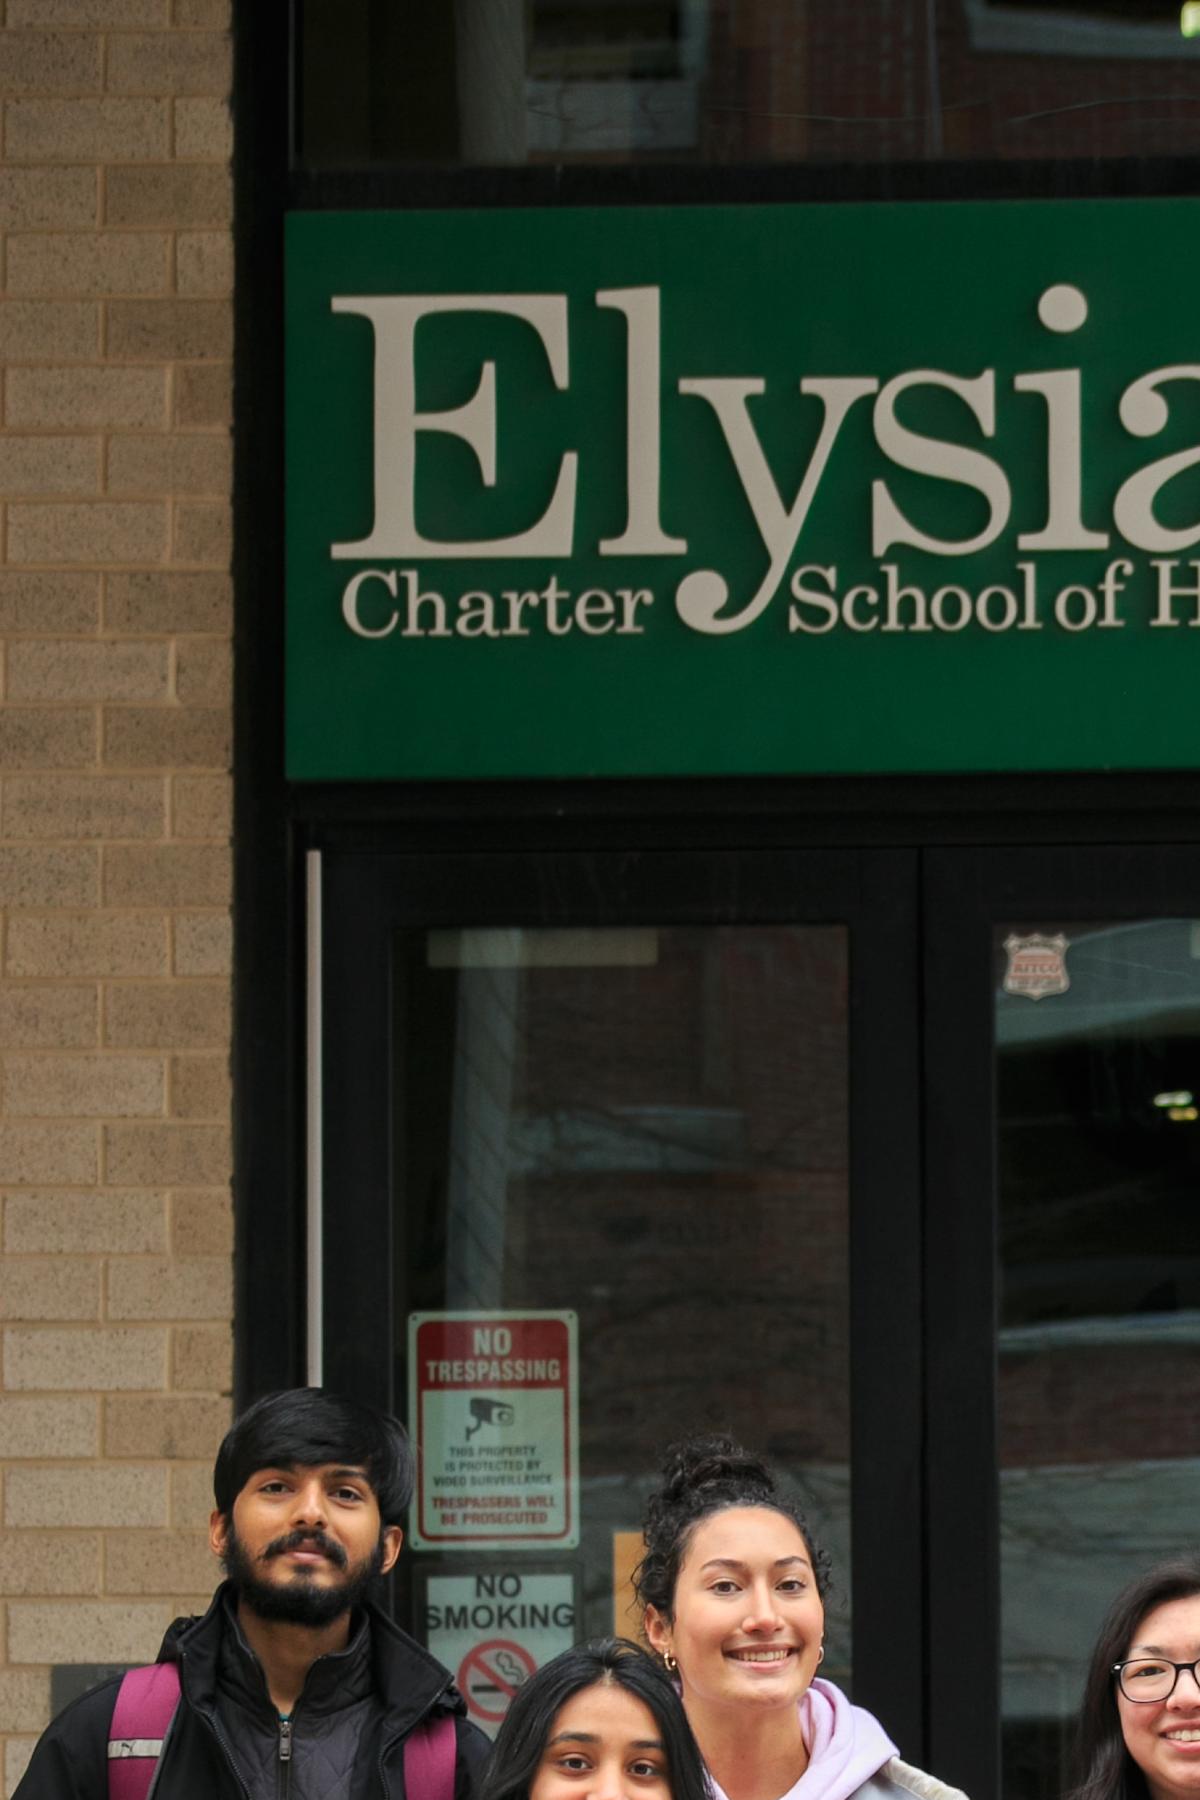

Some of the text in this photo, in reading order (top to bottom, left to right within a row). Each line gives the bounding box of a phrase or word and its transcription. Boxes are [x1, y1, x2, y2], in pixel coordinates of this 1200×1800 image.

[342, 569, 653, 638] Charter
[788, 563, 1042, 635] School
[1055, 559, 1134, 632] of
[473, 1328, 512, 1356] NO
[426, 1359, 560, 1382] TRESPASSING
[450, 1444, 537, 1458] THIS PROPERTY
[459, 1460, 523, 1472] PROTECTED
[527, 1460, 541, 1471] BY
[434, 1474, 552, 1487] VIDEO SURVEILLANCE
[432, 1495, 555, 1509] TRESPASSERS WILL
[441, 1511, 548, 1525] BE PROSECUTED
[475, 1574, 522, 1598] NO
[424, 1604, 576, 1630] SMOKING
